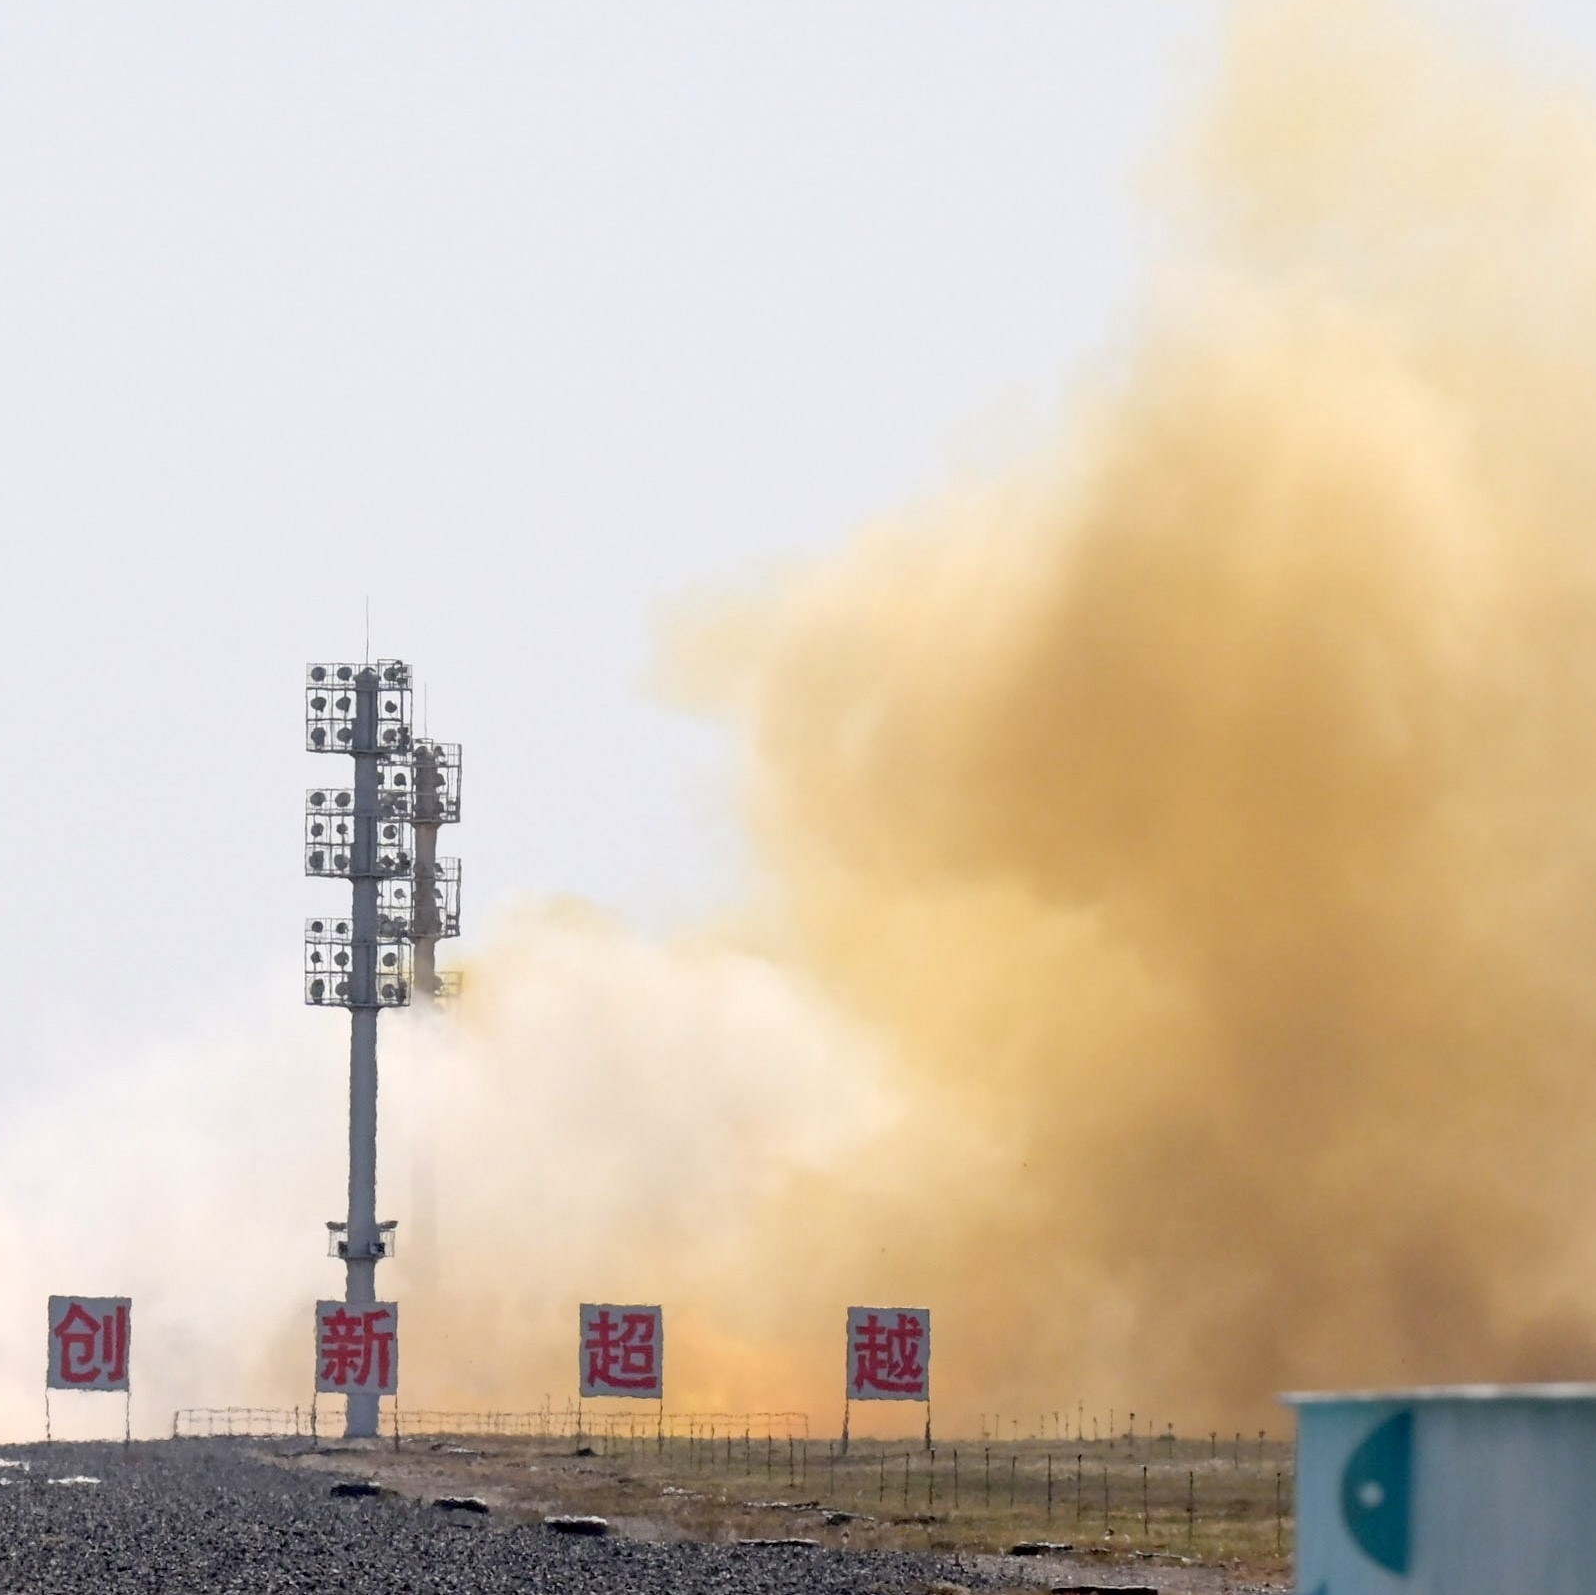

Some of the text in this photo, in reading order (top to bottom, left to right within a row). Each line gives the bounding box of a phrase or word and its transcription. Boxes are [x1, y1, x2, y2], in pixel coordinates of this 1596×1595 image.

[55, 1304, 924, 1393] 创 新 超 越
